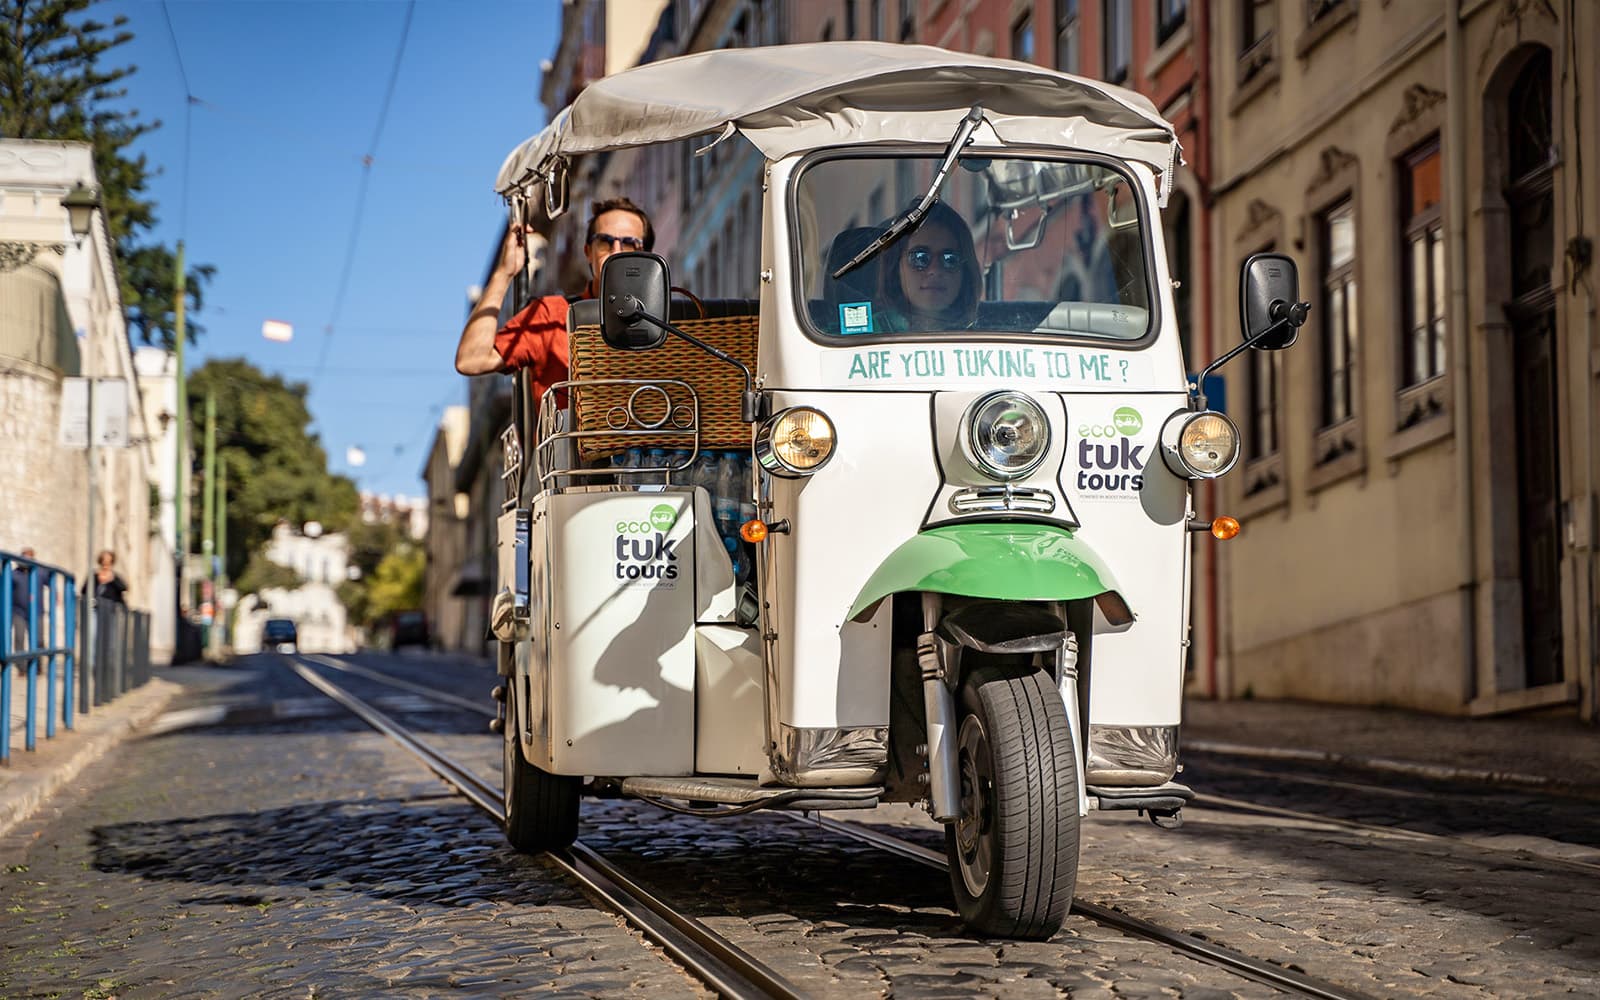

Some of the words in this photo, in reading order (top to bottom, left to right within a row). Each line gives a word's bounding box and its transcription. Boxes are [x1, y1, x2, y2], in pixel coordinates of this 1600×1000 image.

[848, 350, 891, 380] ARE
[899, 350, 945, 377] YOU
[953, 349, 1036, 378] TUKING
[1042, 351, 1071, 379] TO
[1079, 354, 1112, 381] ME
[1119, 359, 1129, 383] ?
[1078, 424, 1116, 437] eco
[1078, 437, 1144, 470] tuk
[1077, 470, 1144, 491] tours
[616, 521, 651, 534] eco
[616, 532, 677, 561] tuk
[616, 562, 678, 580] tours
